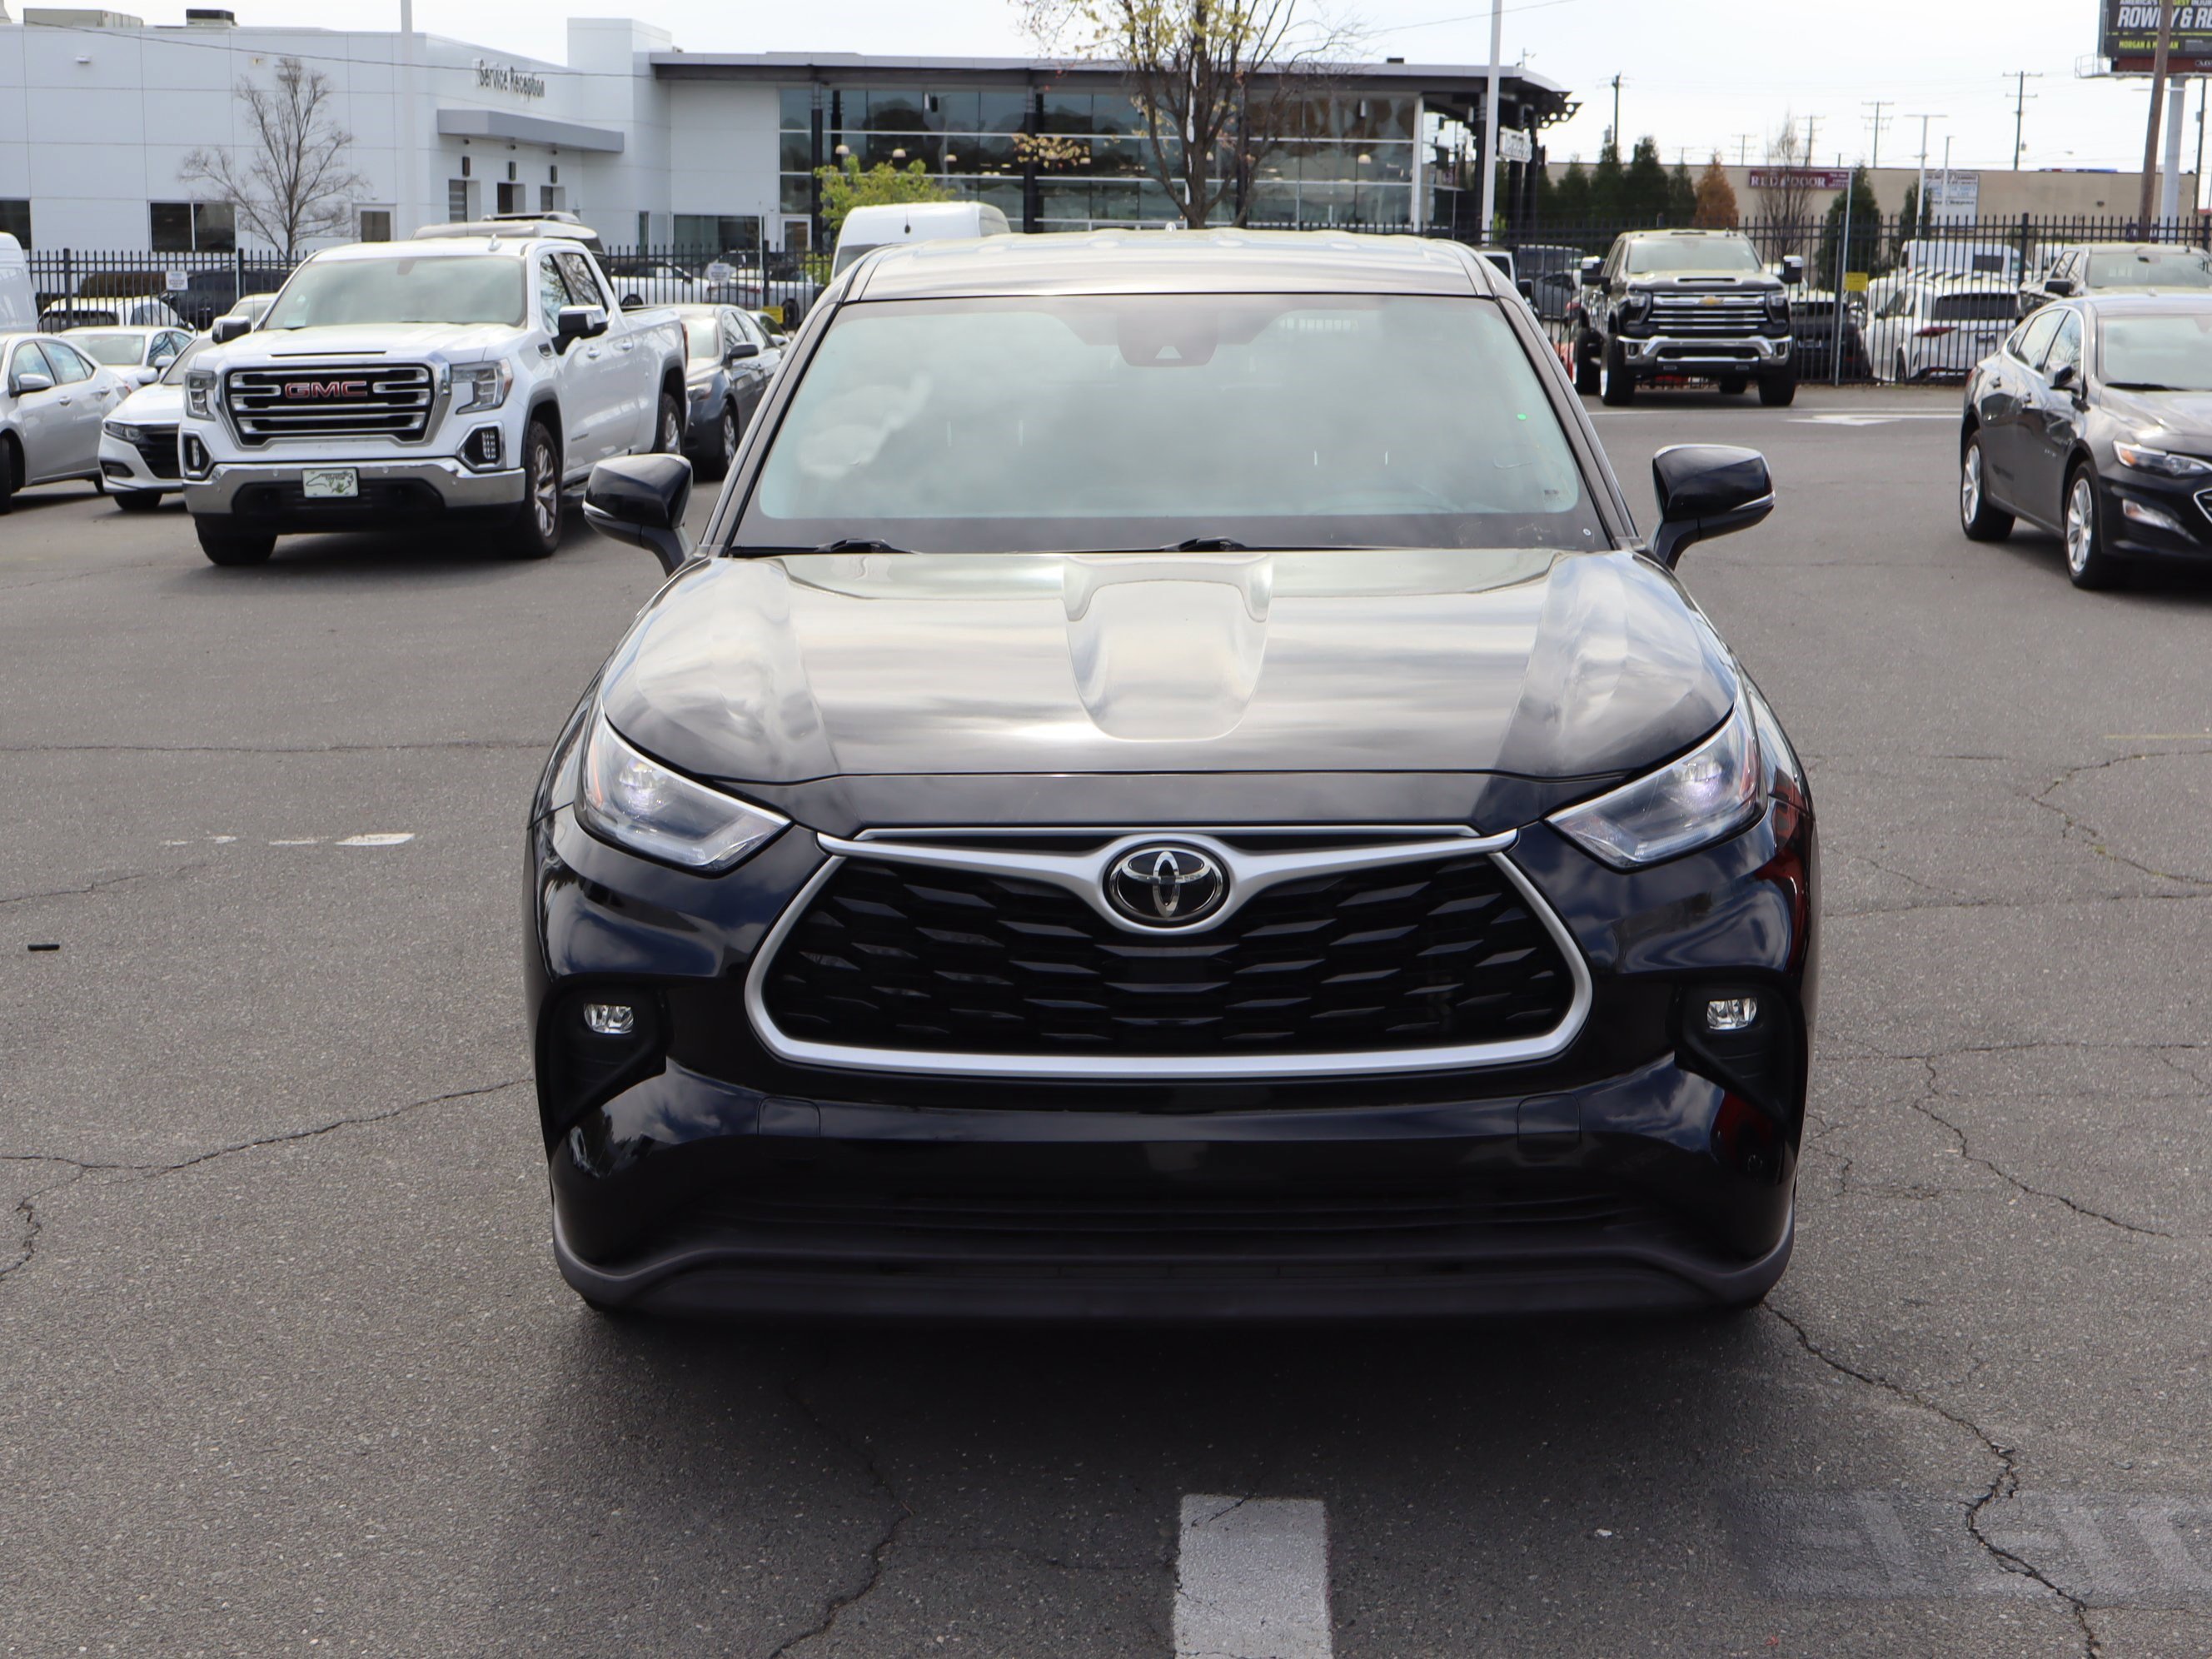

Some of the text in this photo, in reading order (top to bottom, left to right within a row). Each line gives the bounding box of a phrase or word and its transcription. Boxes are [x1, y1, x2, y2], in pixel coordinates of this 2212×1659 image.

[2180, 7, 2194, 28] &
[479, 59, 546, 102] Service Reception
[285, 381, 367, 398] GMC
